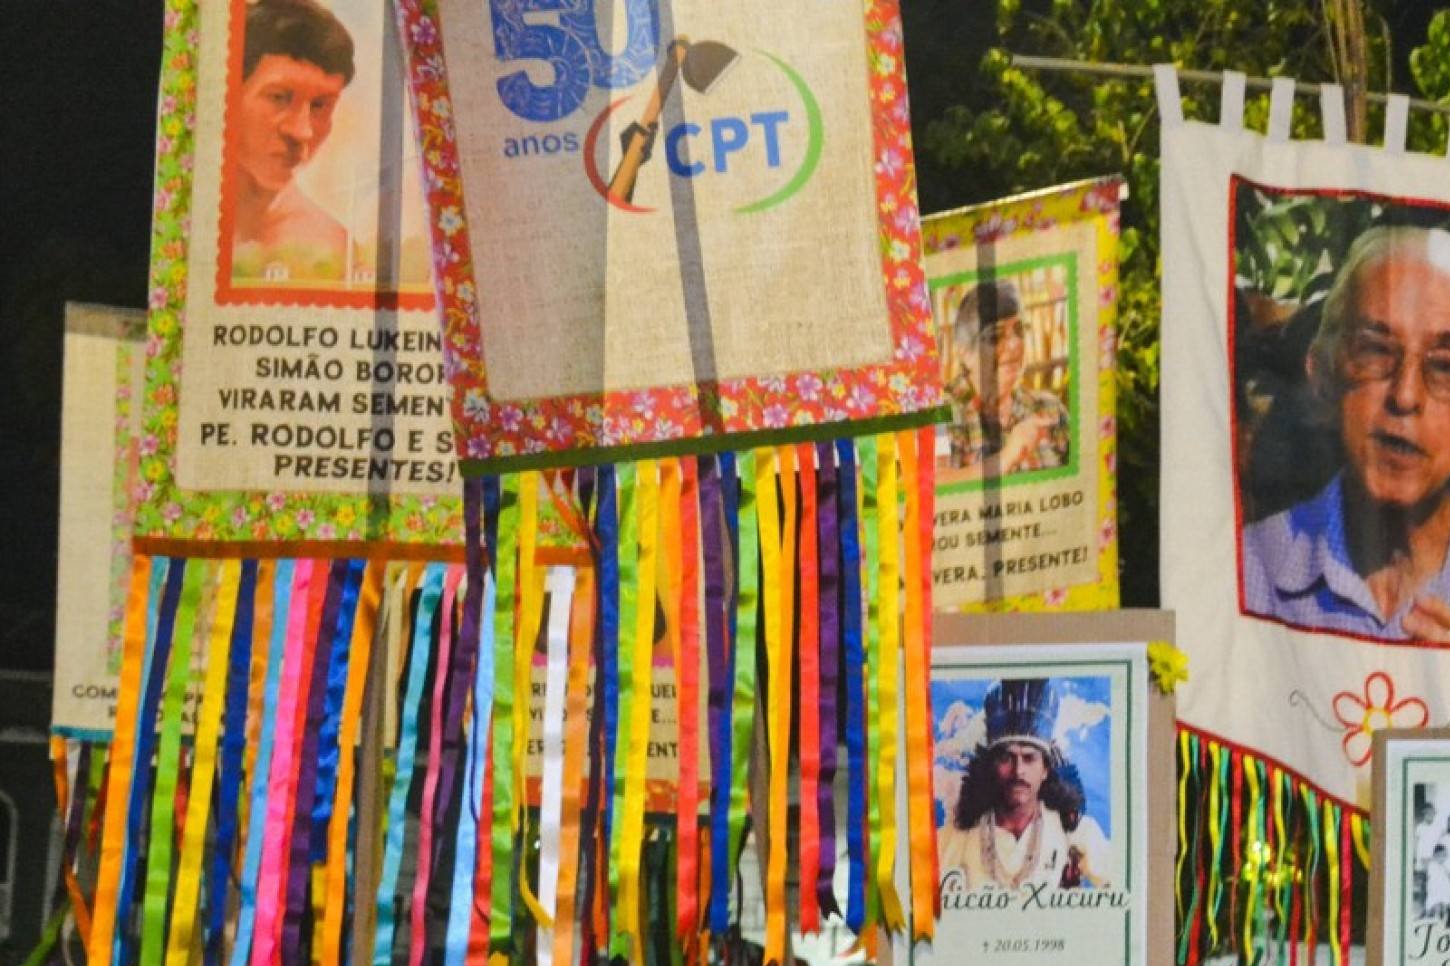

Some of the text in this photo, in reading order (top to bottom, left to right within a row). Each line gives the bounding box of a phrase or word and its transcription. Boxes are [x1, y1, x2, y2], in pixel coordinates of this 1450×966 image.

[504, 132, 580, 158] anos
[664, 111, 790, 179] CPT
[213, 324, 338, 347] RODOLFO
[256, 352, 343, 380] SIMÃO
[218, 388, 341, 413] VIRARAM
[200, 422, 237, 446] PE.
[251, 423, 395, 450] RODOLFO
[408, 430, 424, 452] E
[273, 454, 456, 482] PRESENTES!
[979, 500, 1034, 519] MARIA
[1039, 490, 1084, 512] LOBO
[992, 546, 1089, 576] PRESENTE!
